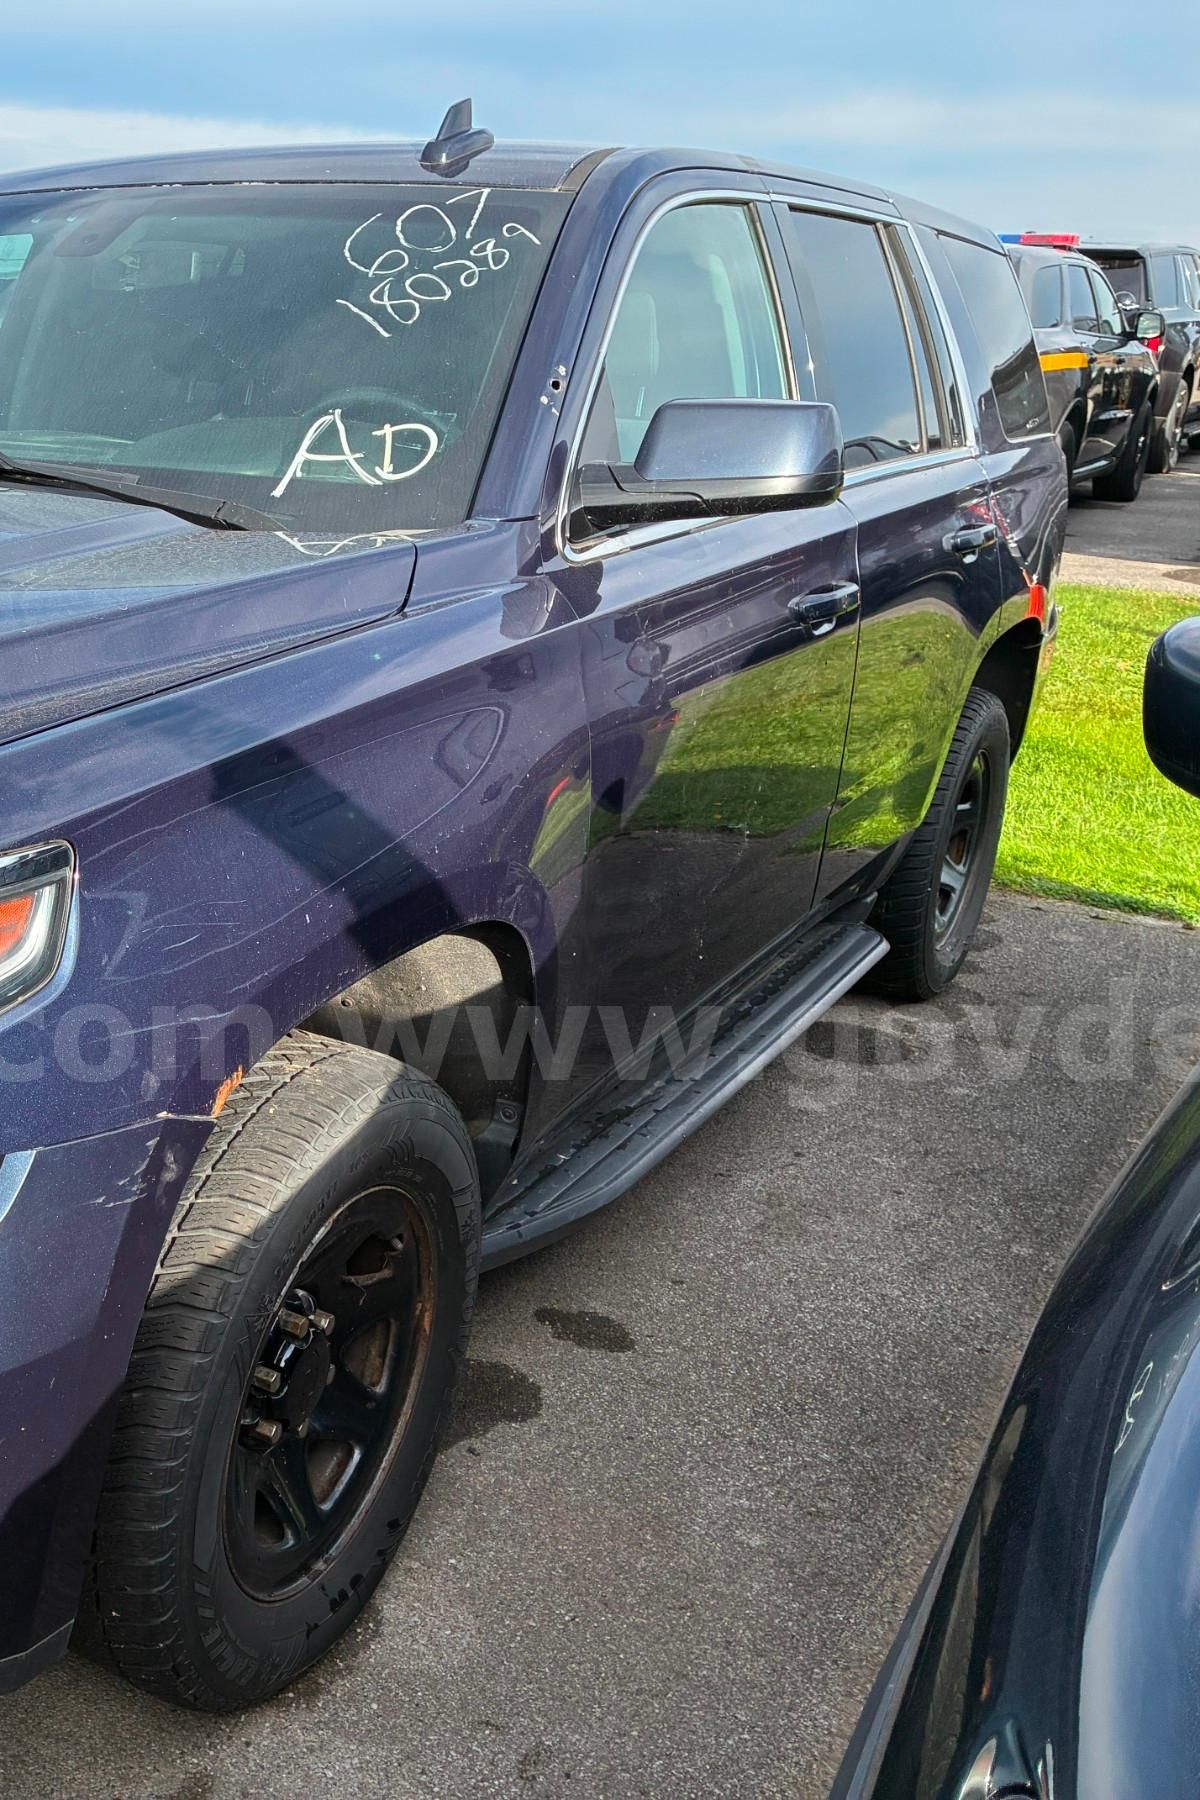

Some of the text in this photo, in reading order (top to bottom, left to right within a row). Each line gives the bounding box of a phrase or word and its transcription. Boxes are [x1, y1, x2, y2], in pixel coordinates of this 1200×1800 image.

[344, 187, 491, 277] 607
[335, 222, 542, 338] 180289
[270, 407, 439, 498] AD
